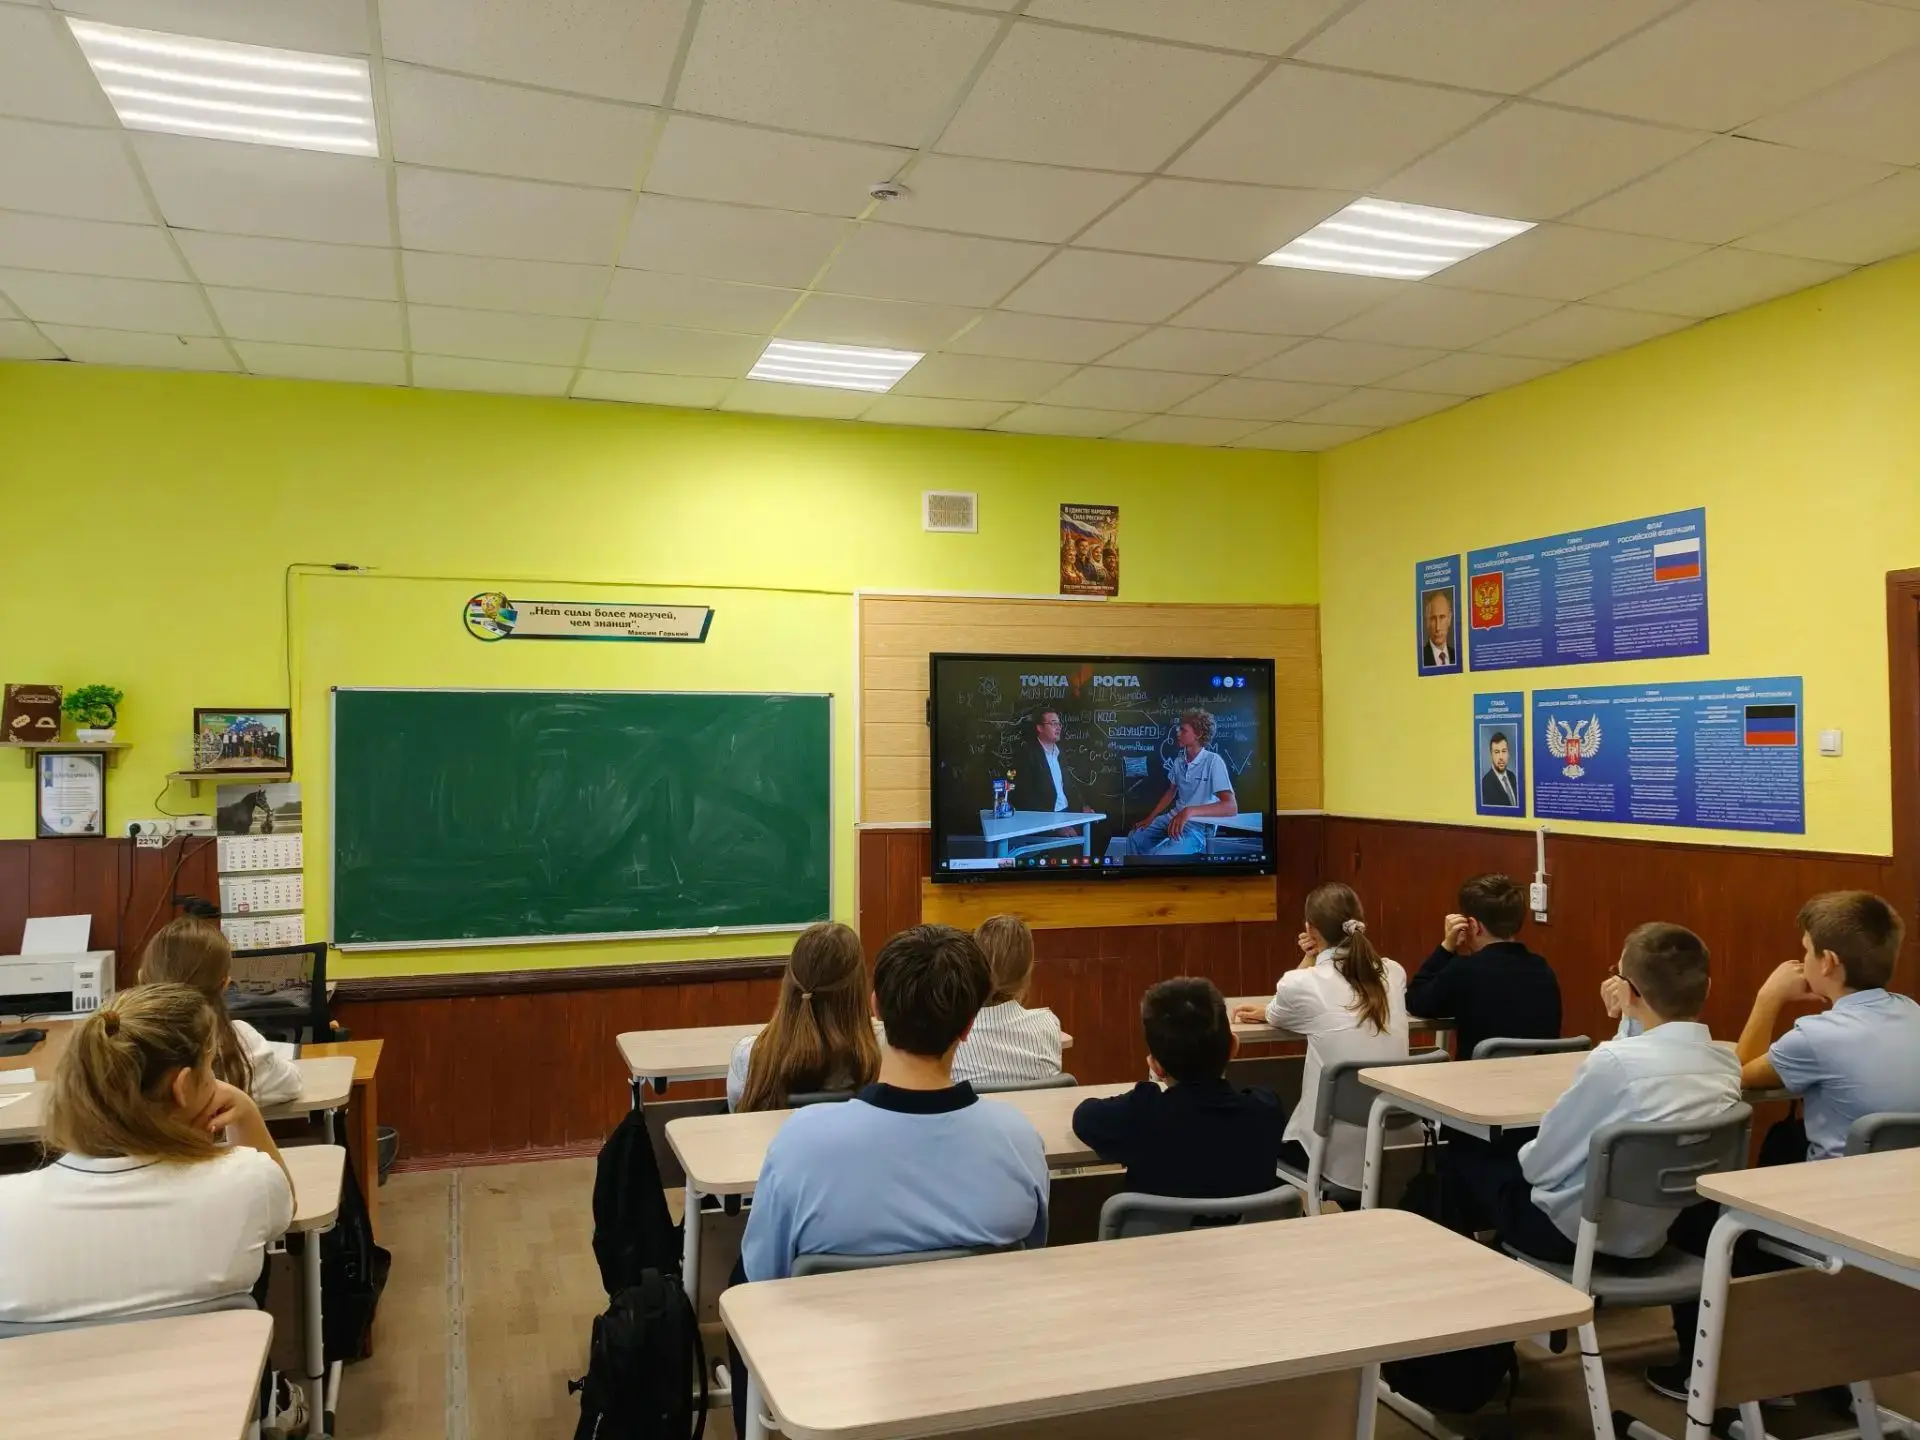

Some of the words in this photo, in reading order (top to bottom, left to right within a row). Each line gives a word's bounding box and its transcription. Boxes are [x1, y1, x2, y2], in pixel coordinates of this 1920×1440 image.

[564, 609, 592, 618] силы
[594, 608, 626, 619] более
[629, 610, 677, 621] могучей,
[1020, 675, 1069, 687] ТОЧКА
[1094, 676, 1140, 687] РОСТА
[1108, 727, 1156, 737] БУДУЩЕГО
